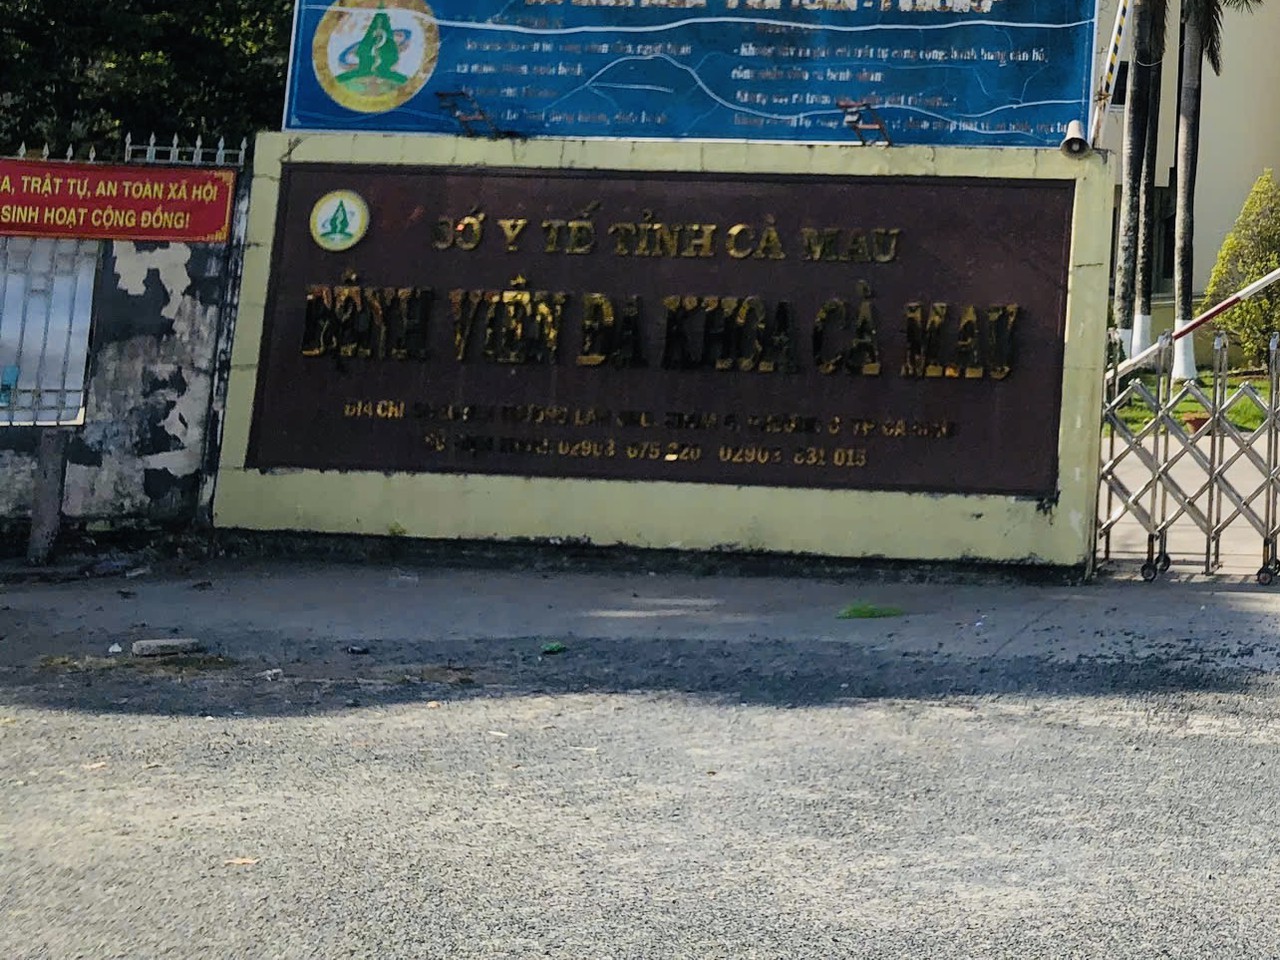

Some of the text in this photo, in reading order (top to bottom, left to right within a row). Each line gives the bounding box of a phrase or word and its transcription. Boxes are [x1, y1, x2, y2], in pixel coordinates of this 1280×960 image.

[21, 172, 63, 198] TRẬT
[95, 180, 118, 197] AN
[123, 178, 164, 200] TOÀN
[191, 181, 218, 204] HỘI
[0, 204, 39, 224] SINH
[43, 206, 88, 229] HOẠT
[91, 204, 137, 230] CỘNG
[497, 218, 528, 252] Y
[606, 208, 718, 258] TỈNH
[725, 214, 787, 260] CÀ
[799, 226, 900, 263] MAU
